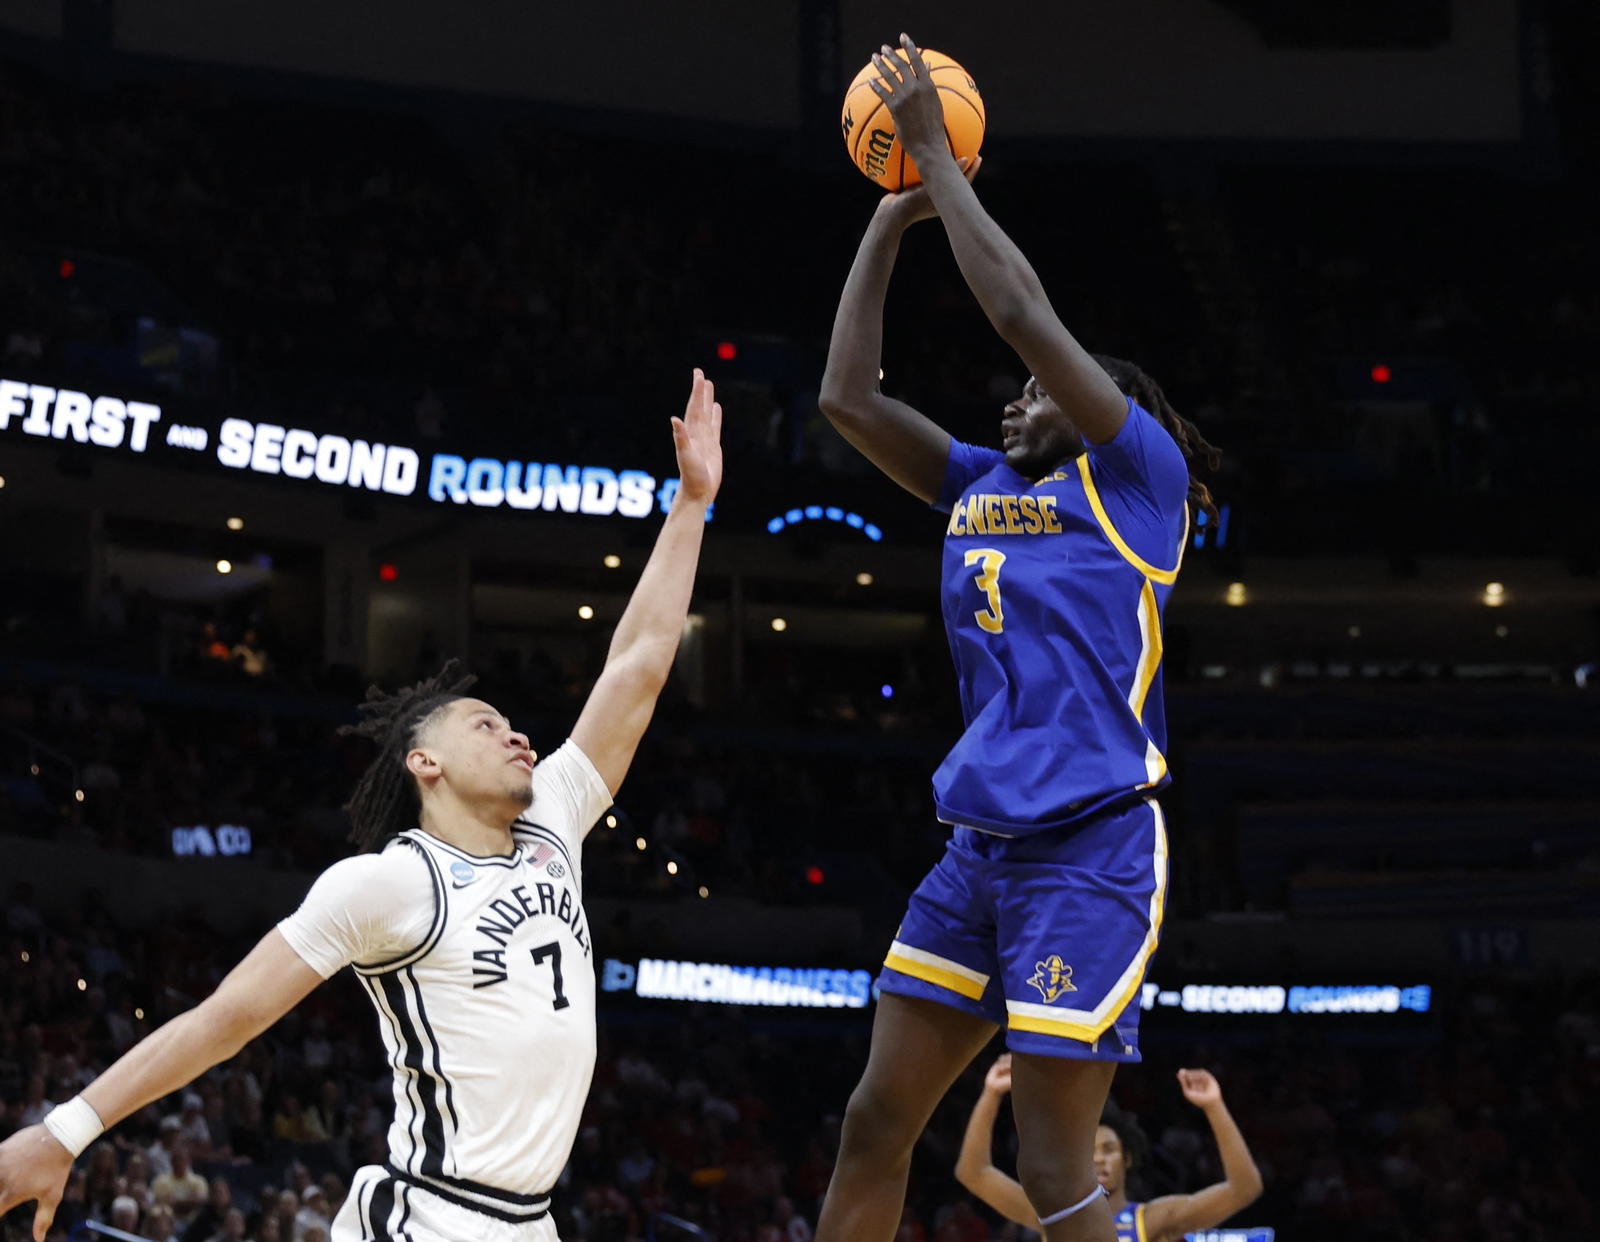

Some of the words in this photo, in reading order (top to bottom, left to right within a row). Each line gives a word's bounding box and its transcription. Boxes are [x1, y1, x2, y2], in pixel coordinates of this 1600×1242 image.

[0, 379, 161, 452] FIRST
[217, 417, 419, 496] SECOND
[429, 453, 657, 518] ROUNDS
[964, 548, 1007, 635] 3
[530, 941, 570, 1011] 7
